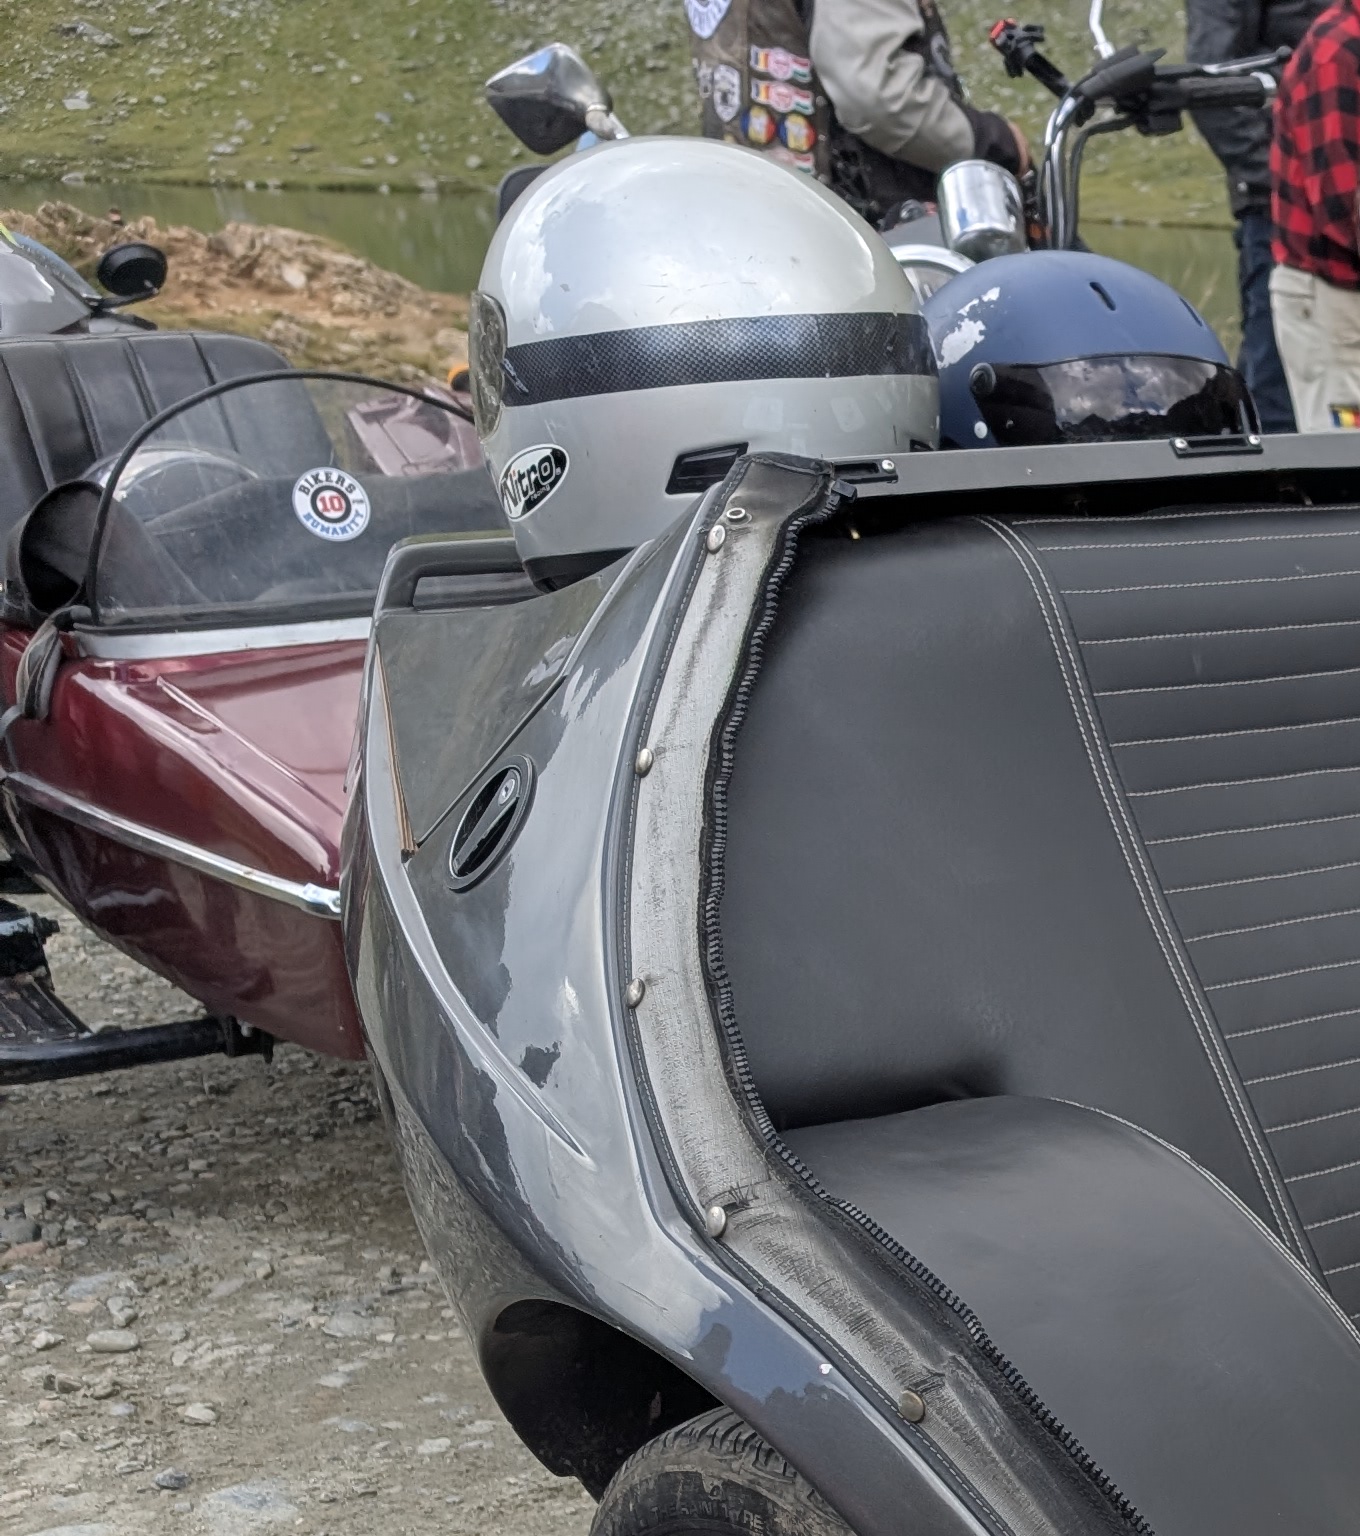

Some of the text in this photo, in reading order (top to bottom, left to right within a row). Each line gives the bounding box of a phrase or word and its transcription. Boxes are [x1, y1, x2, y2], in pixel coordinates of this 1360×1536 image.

[298, 470, 357, 496] BIKERS
[502, 453, 556, 515] Nitro
[319, 495, 345, 512] 10
[303, 509, 364, 536] HUMANITY
